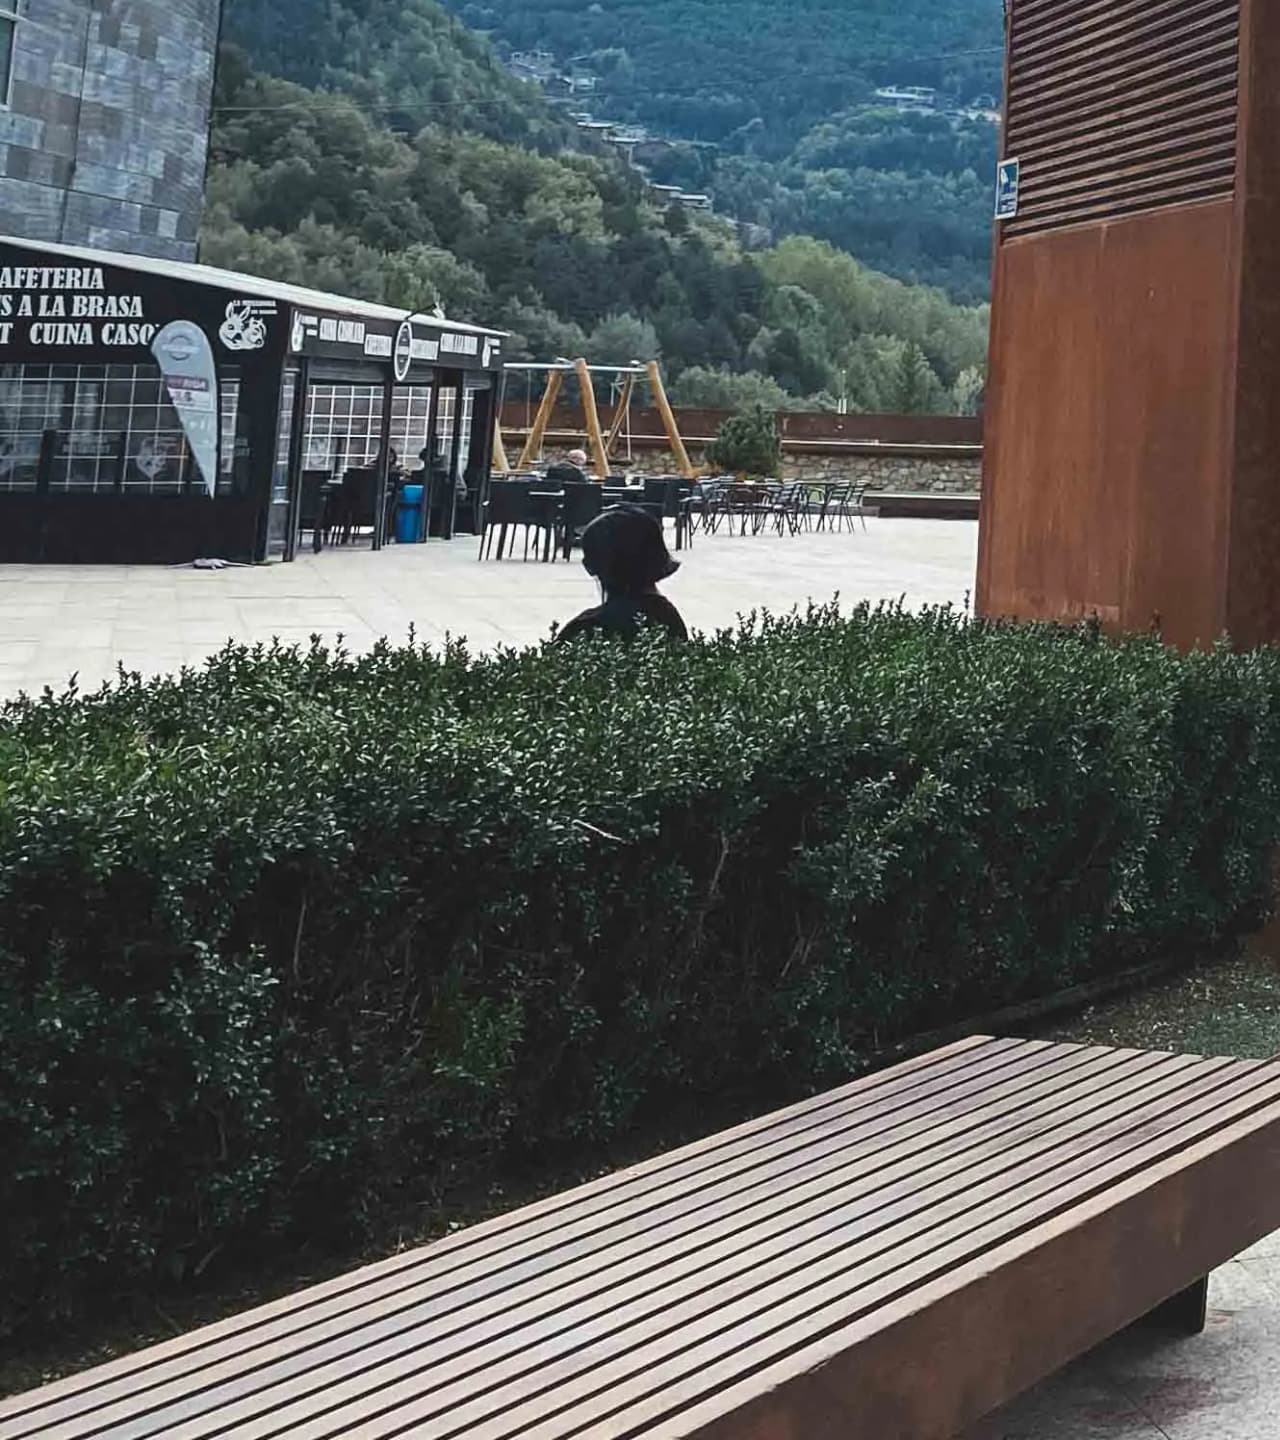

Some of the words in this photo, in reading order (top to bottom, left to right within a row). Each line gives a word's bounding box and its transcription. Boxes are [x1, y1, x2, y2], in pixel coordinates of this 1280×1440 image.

[0, 294, 12, 316] S
[17, 295, 33, 316] A
[38, 295, 66, 317] LA
[71, 296, 143, 317] BRASA
[30, 323, 93, 344] CUINA
[101, 323, 160, 345] CASO
